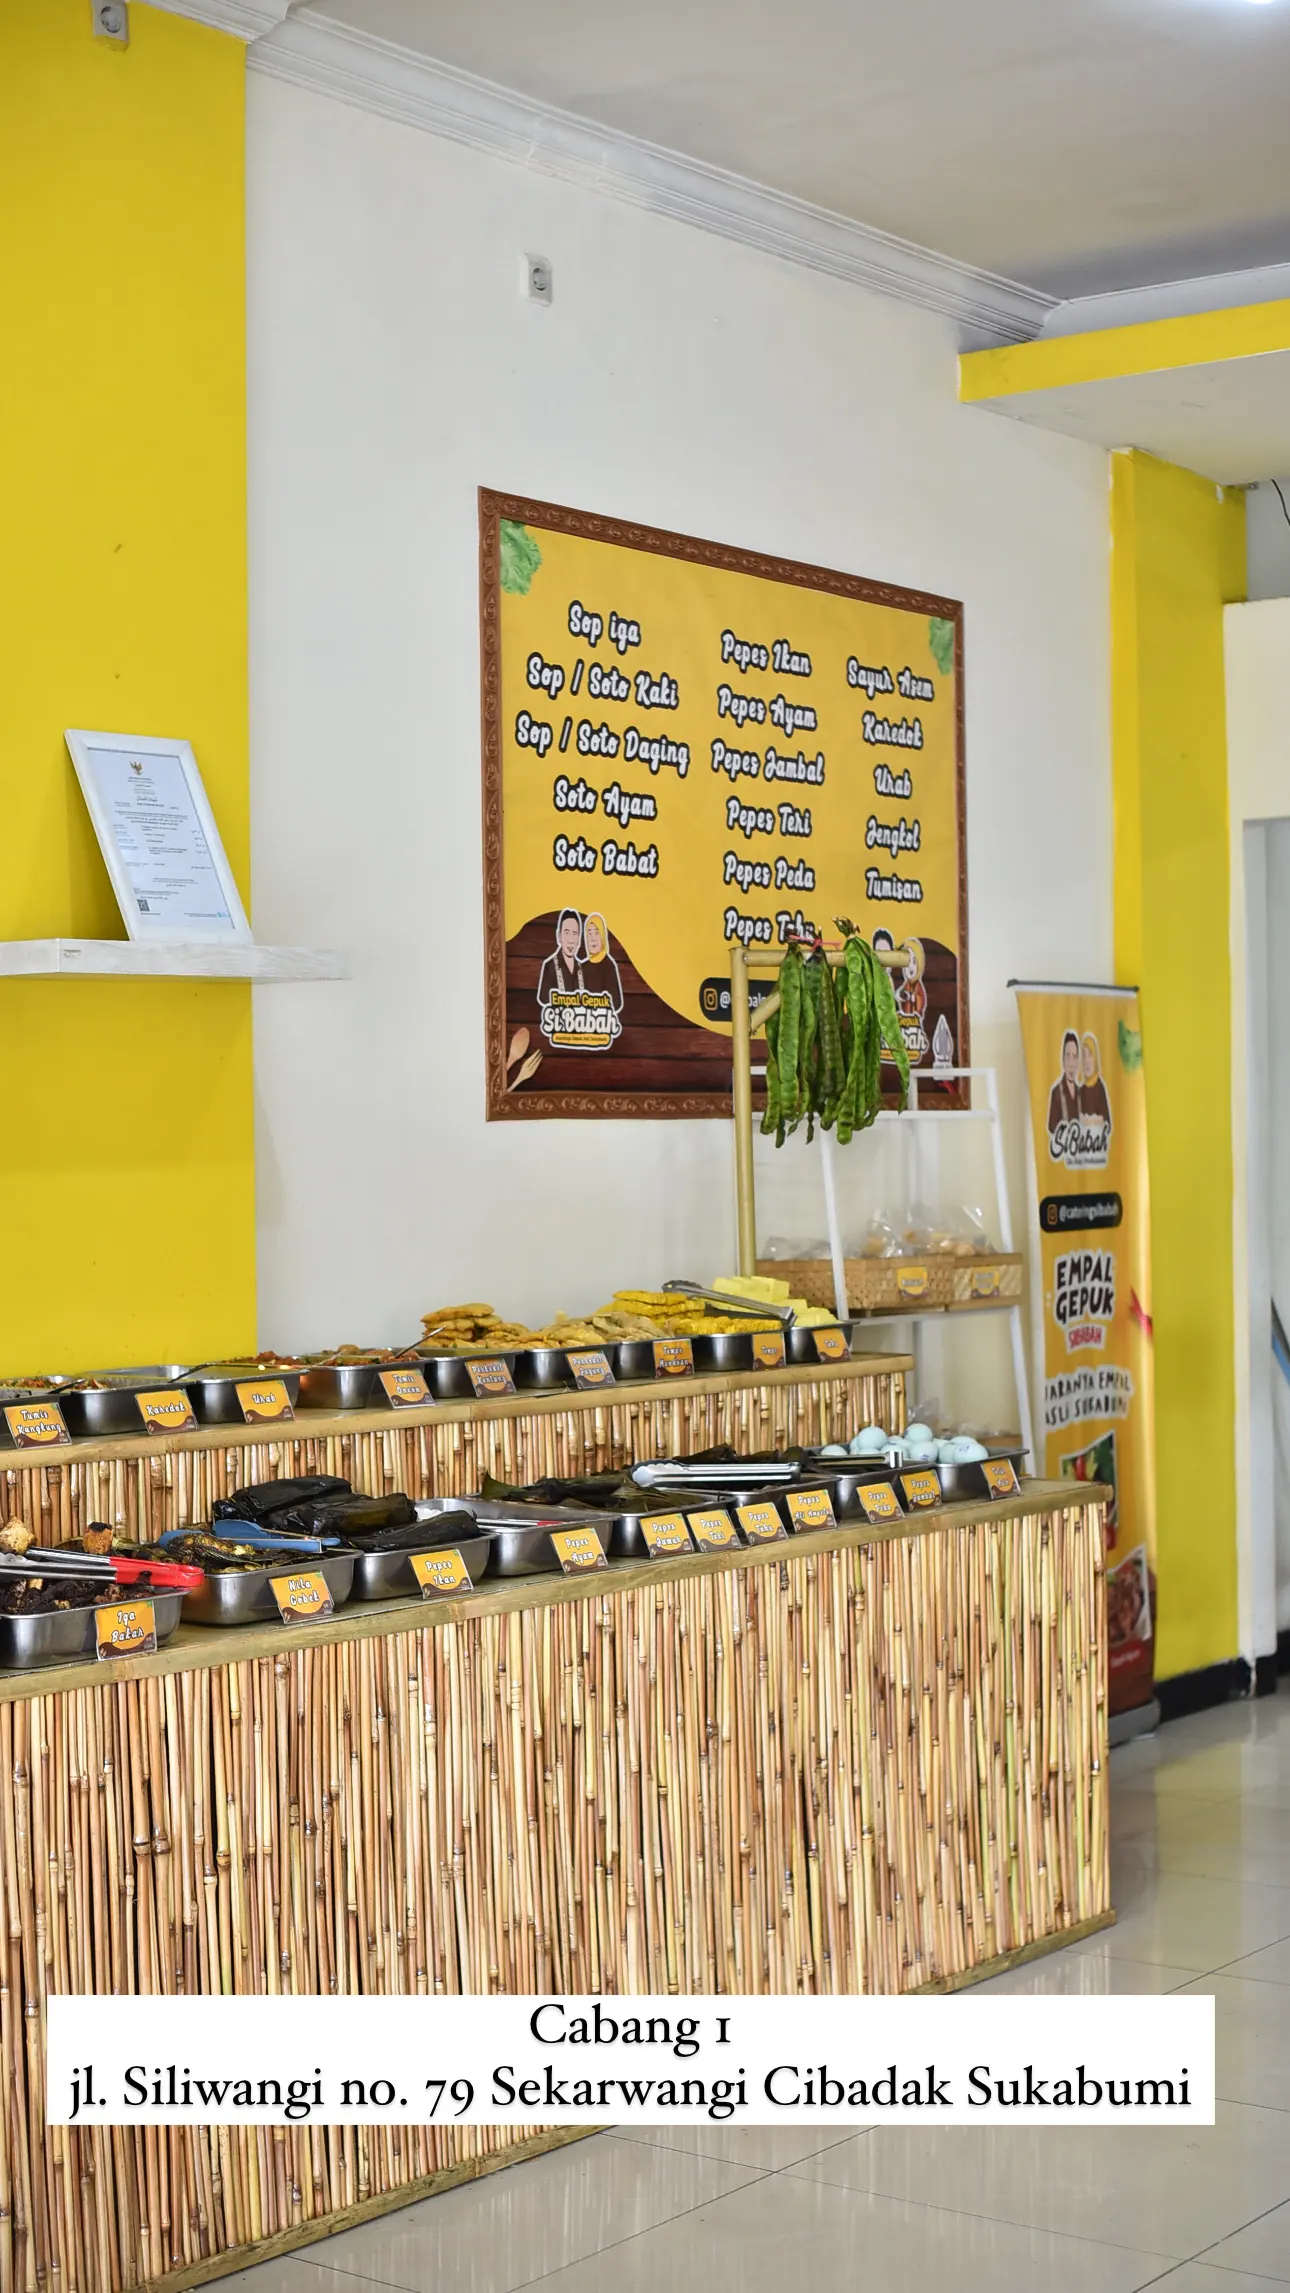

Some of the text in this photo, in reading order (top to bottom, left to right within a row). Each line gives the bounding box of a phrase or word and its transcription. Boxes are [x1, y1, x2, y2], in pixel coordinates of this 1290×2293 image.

[569, 601, 641, 653] Sop iga
[721, 629, 811, 677] Pepes Ikan
[527, 653, 678, 709] Sop / Soto Kaki
[846, 657, 934, 700] Sayur Asem
[717, 684, 817, 736] Pepes Ayam
[515, 710, 689, 778] Sop / Soto Daging
[862, 711, 923, 749] Karedok
[711, 738, 824, 786] Pepes Jambal
[874, 765, 912, 799] Urab
[554, 780, 657, 828] Soto Ayam
[726, 796, 811, 837] Pepes Teri
[554, 834, 658, 878] Soto Babat
[866, 816, 920, 857] Jengkol
[724, 850, 815, 893] Pepes Peda
[866, 868, 922, 902] Tumisan
[724, 906, 773, 946] Pepes
[552, 993, 611, 1008] Empal Gepuk
[1057, 1255, 1113, 1290] EMPAL
[1056, 1286, 1114, 1325] GEPUK
[16, 1422, 62, 1436] Kangkung
[20, 1410, 49, 1421] Tumis
[565, 1537, 590, 1549] Pepes
[288, 1578, 313, 1591] Nila
[425, 1559, 453, 1573] Pepes
[289, 1589, 321, 1607] Cobek
[110, 1626, 145, 1644] Bakar
